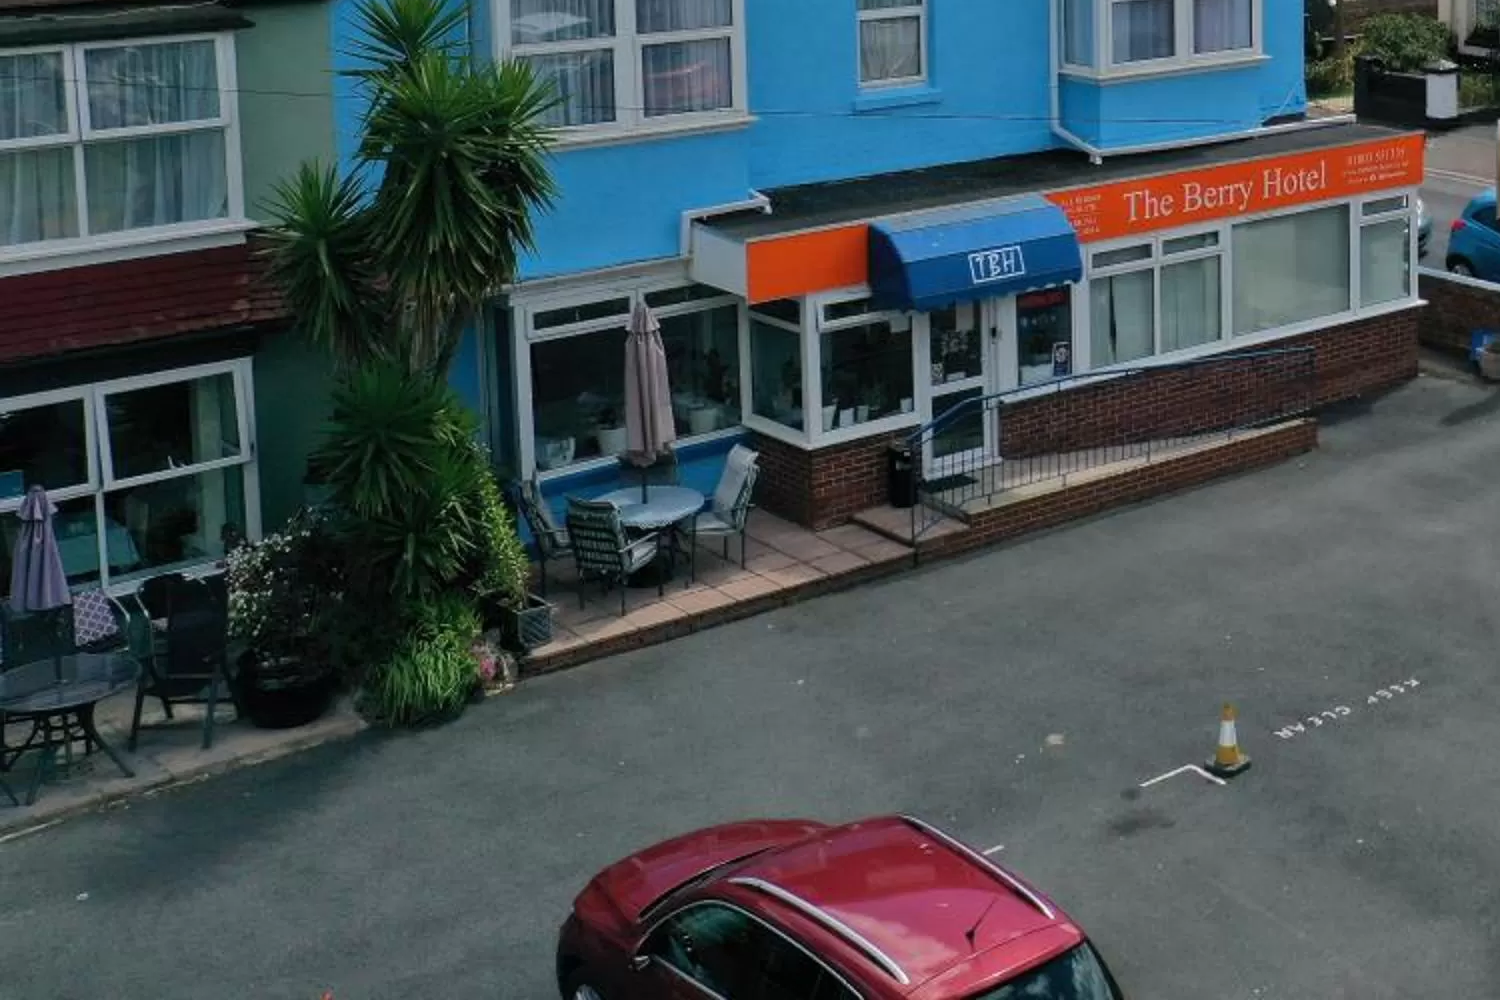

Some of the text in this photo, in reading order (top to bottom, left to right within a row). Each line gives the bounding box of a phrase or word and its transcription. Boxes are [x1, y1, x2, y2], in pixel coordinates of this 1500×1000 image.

[1123, 189, 1174, 222] The
[1182, 181, 1253, 213] Berry
[1263, 160, 1326, 199] Hotel
[974, 249, 1015, 280] TBH
